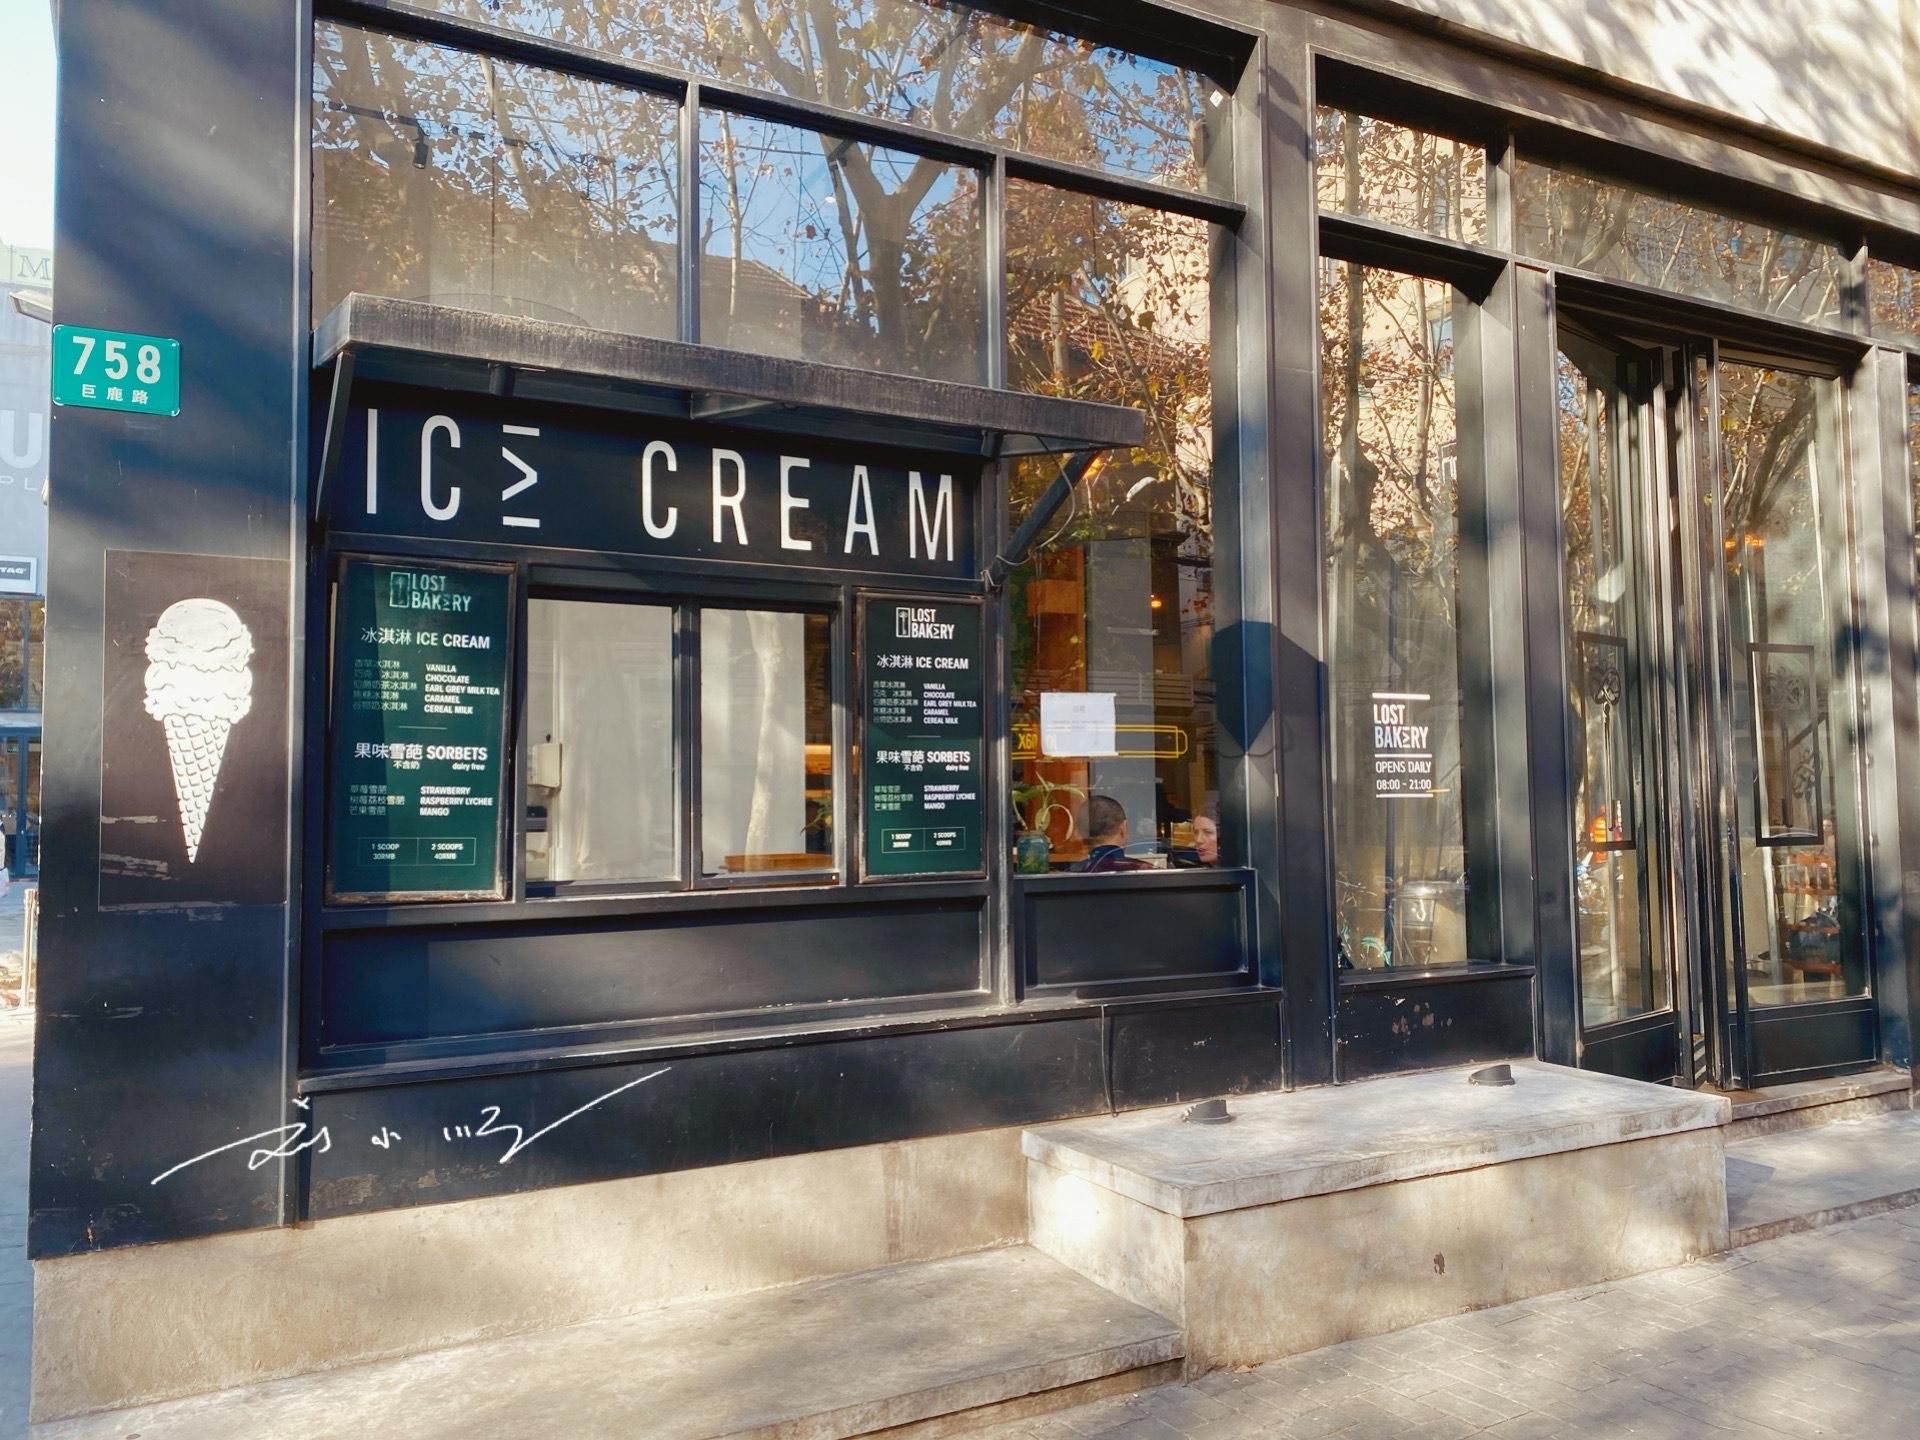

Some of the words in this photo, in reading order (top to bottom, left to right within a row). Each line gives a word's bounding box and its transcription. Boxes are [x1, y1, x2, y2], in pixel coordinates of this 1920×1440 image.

[72, 335, 161, 385] 758
[82, 384, 149, 405] 巨鹿路
[366, 408, 540, 528] ICE
[641, 440, 954, 561] CREAM
[412, 573, 446, 591] LOST
[411, 591, 472, 612] BAKERY
[911, 607, 937, 623] LOST
[911, 623, 955, 640] BAKERY
[361, 627, 412, 646] 冰淇淋
[416, 632, 438, 646] ICE
[442, 633, 490, 649] CREAM
[876, 654, 914, 669] 冰淇淋
[915, 656, 932, 668] ICE
[934, 657, 969, 670] CREAM
[425, 663, 457, 673] VANILLA
[425, 674, 470, 683] CHOCOLATE
[424, 685, 444, 693] EARL
[445, 685, 466, 694] GREY
[467, 686, 486, 694] MILK
[486, 687, 500, 695] TEA
[923, 691, 955, 699] CHOCOLATE
[424, 694, 461, 704] CARAMEL
[424, 704, 453, 714] CEREAL
[454, 705, 473, 714] MILK
[923, 708, 949, 716] CARAMEL
[1373, 704, 1405, 725] LOST
[923, 716, 944, 724] CEREAL
[1374, 726, 1429, 749] BAKERY
[354, 742, 423, 760] 果味雪葩
[426, 746, 488, 761] SORBETS
[927, 751, 971, 764] SORBETS
[452, 762, 470, 772] dairy
[471, 762, 485, 771] free
[1375, 761, 1406, 773] OPENS
[1408, 761, 1432, 773] DAILY
[924, 784, 960, 792] STRAWBERRY
[1376, 779, 1400, 790] 08:00
[1409, 779, 1432, 790] 21:00
[420, 785, 471, 795] STRAWBERRY
[420, 796, 463, 806] RASPBERRY
[465, 796, 493, 806] LYCHEE
[924, 793, 955, 801] RASPBERRY
[924, 802, 946, 810] MANGO
[419, 807, 450, 816] MANGO
[377, 843, 400, 851] SCOOP
[437, 843, 464, 851] SCOOPS
